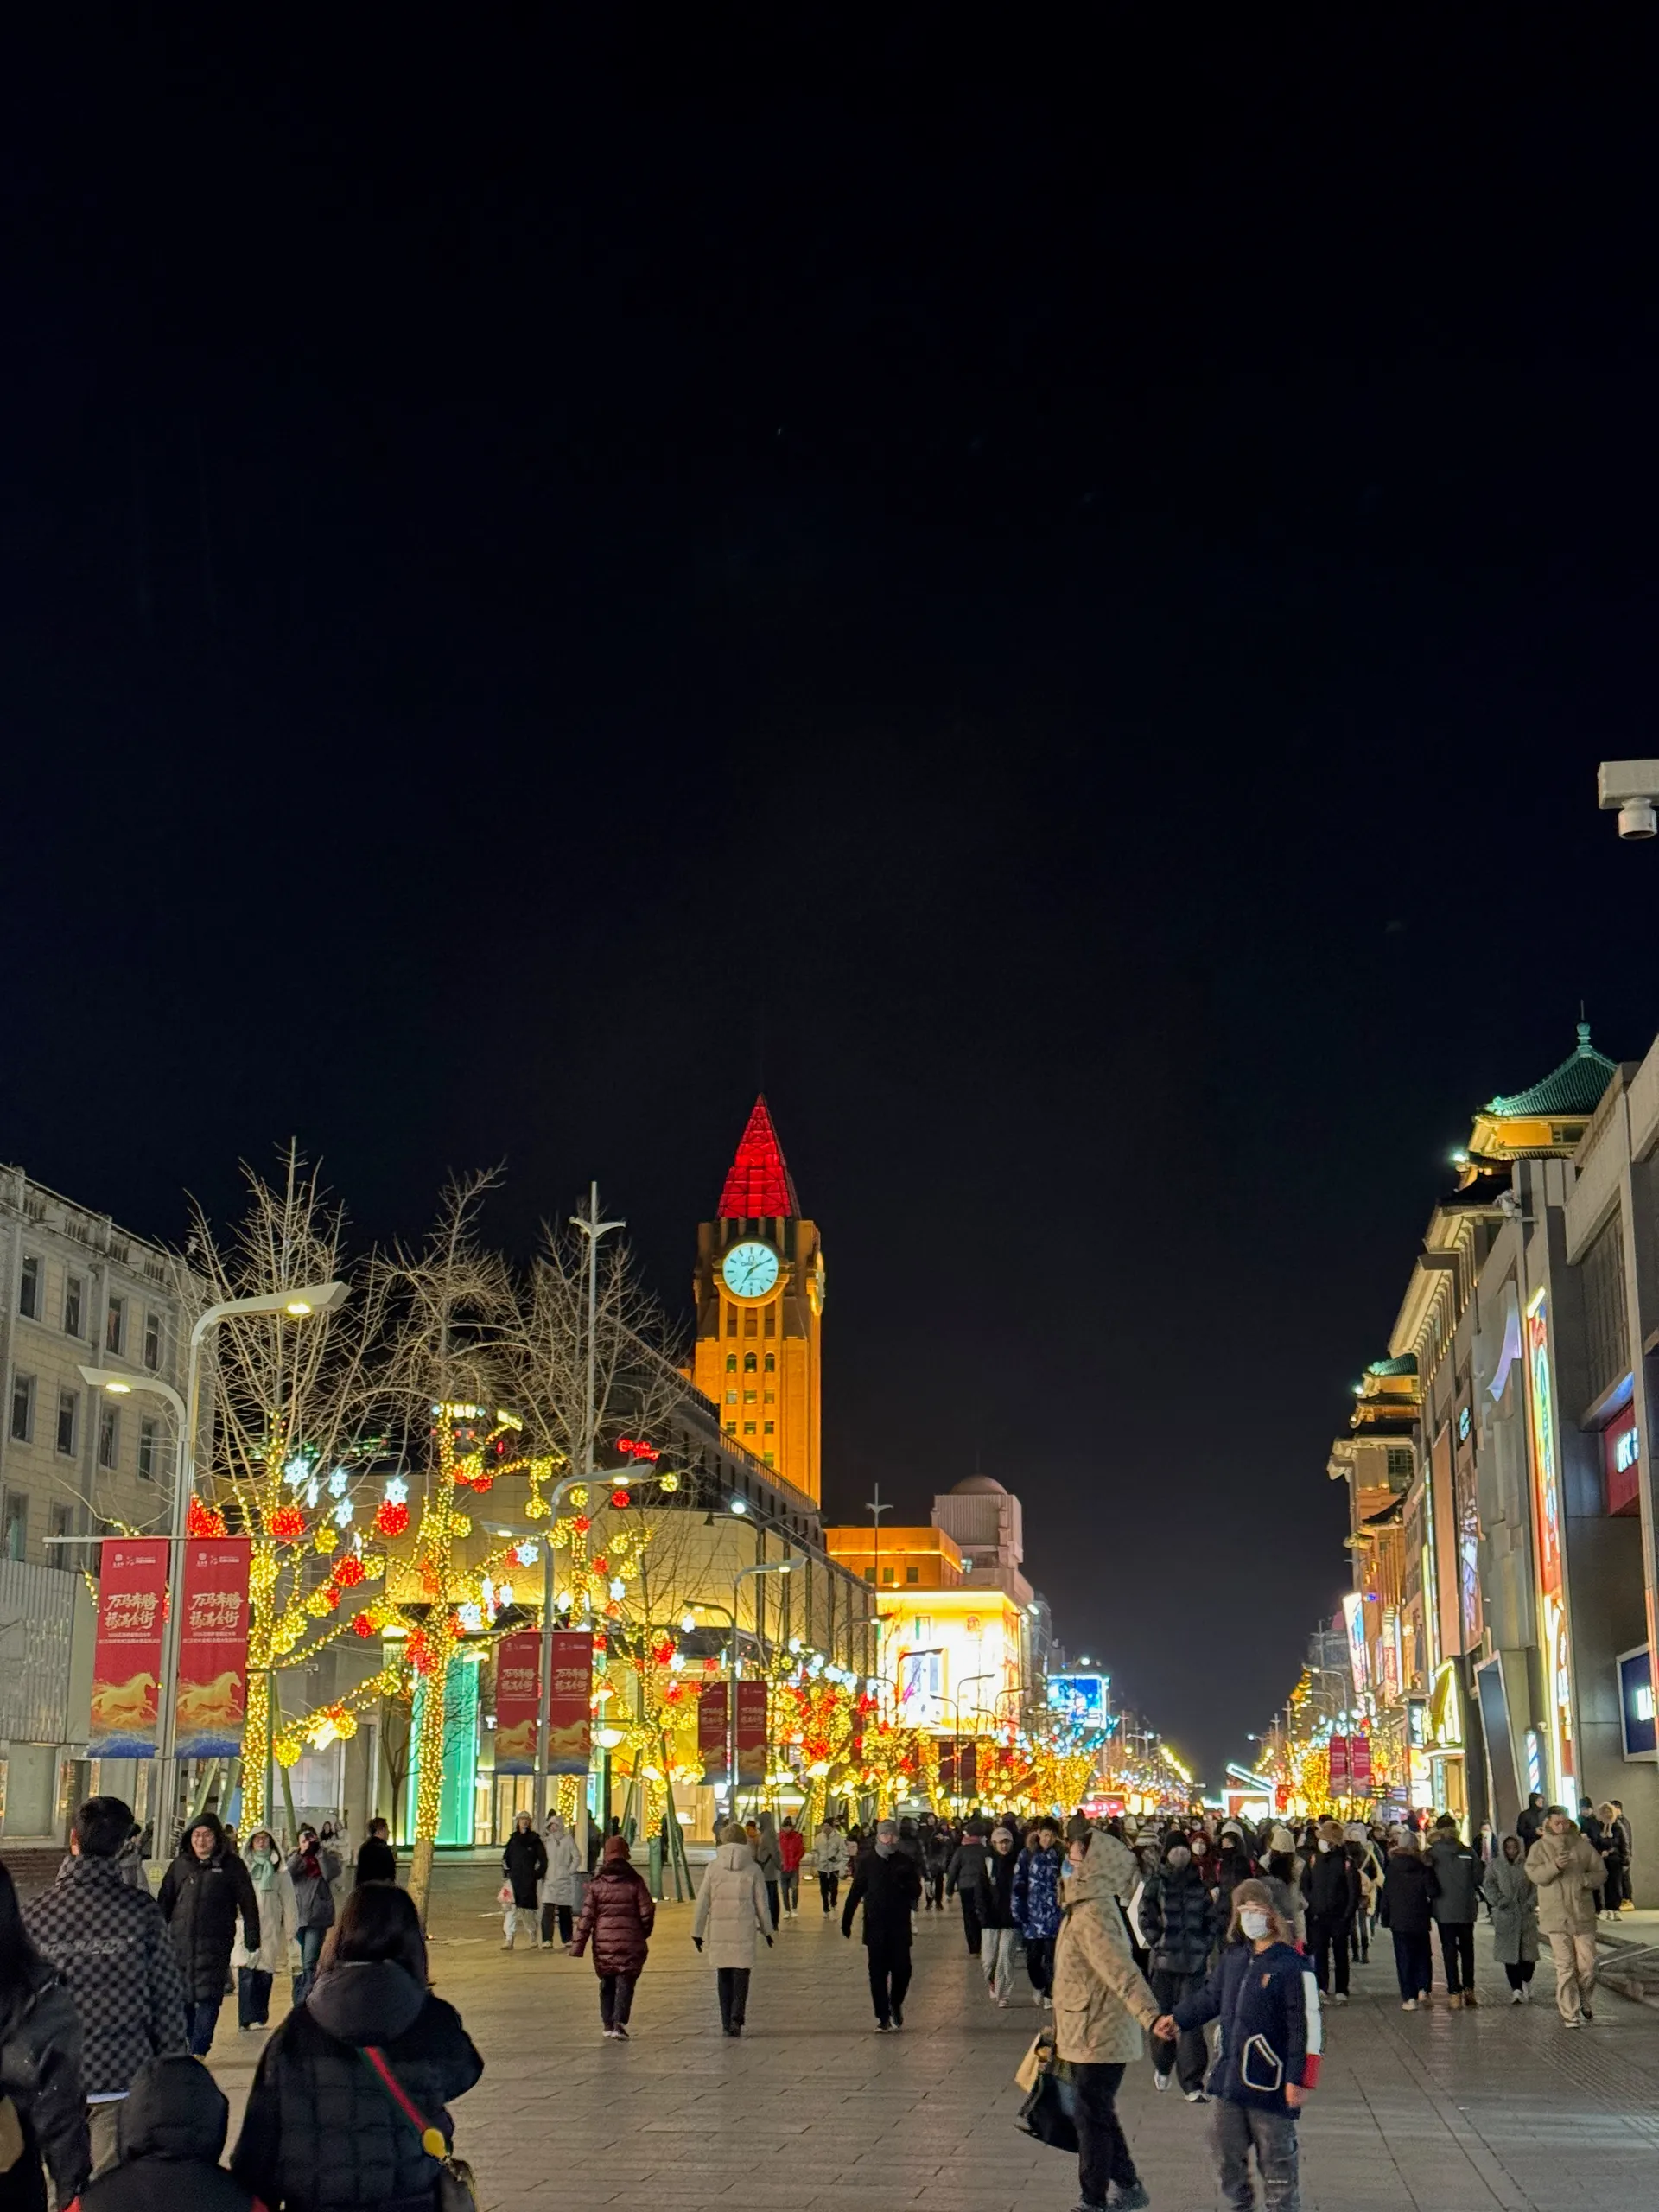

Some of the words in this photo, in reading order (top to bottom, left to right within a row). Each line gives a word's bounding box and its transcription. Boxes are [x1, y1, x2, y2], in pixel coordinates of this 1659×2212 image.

[103, 1592, 159, 1611] 万马奔腾
[188, 1591, 245, 1611] 万马奔腾
[105, 1611, 156, 1631] 福满金街
[189, 1611, 240, 1630] 福满金街
